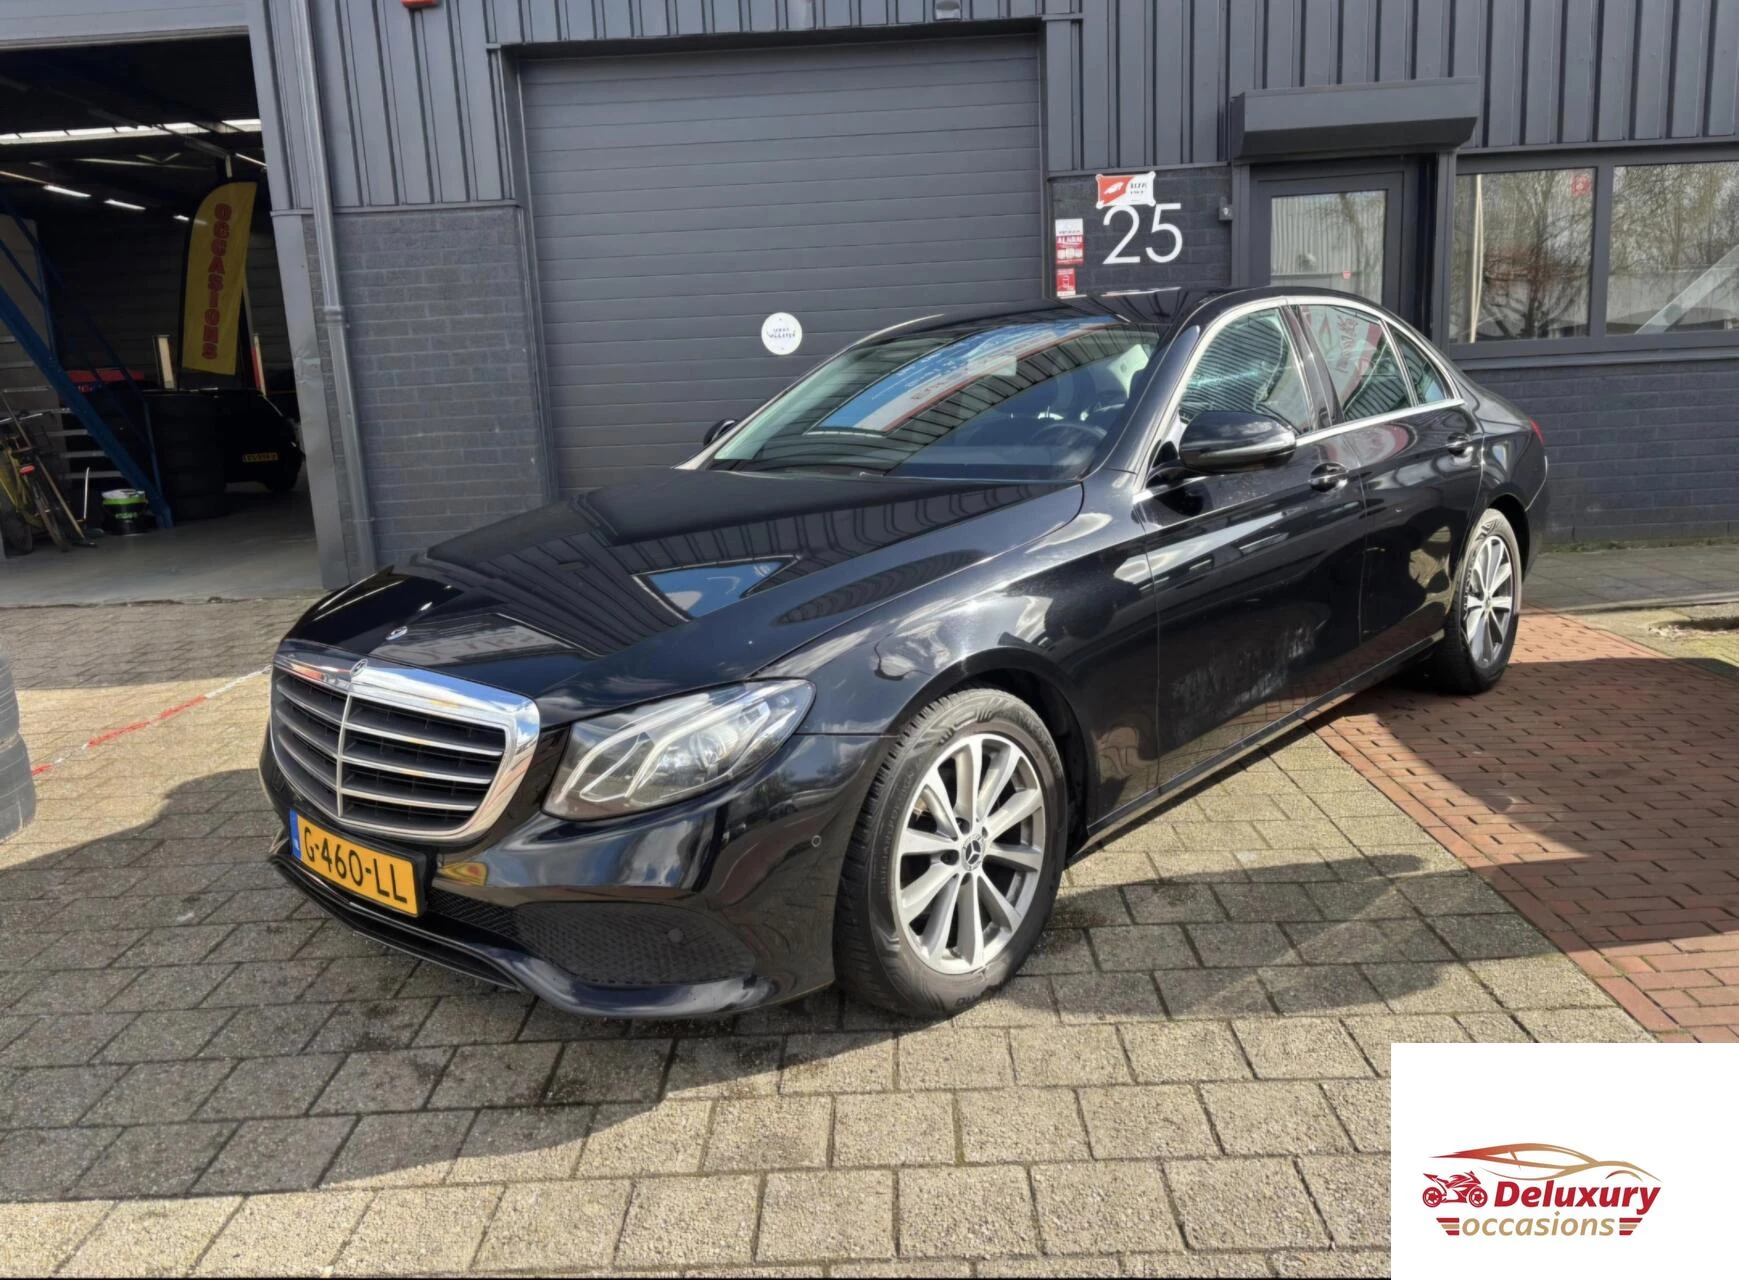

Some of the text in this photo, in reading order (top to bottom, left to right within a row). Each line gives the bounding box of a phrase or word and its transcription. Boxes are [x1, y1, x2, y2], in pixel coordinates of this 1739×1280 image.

[1102, 202, 1183, 265] 25
[201, 202, 232, 360] OCCASIONS
[303, 826, 408, 904] G-460-LL
